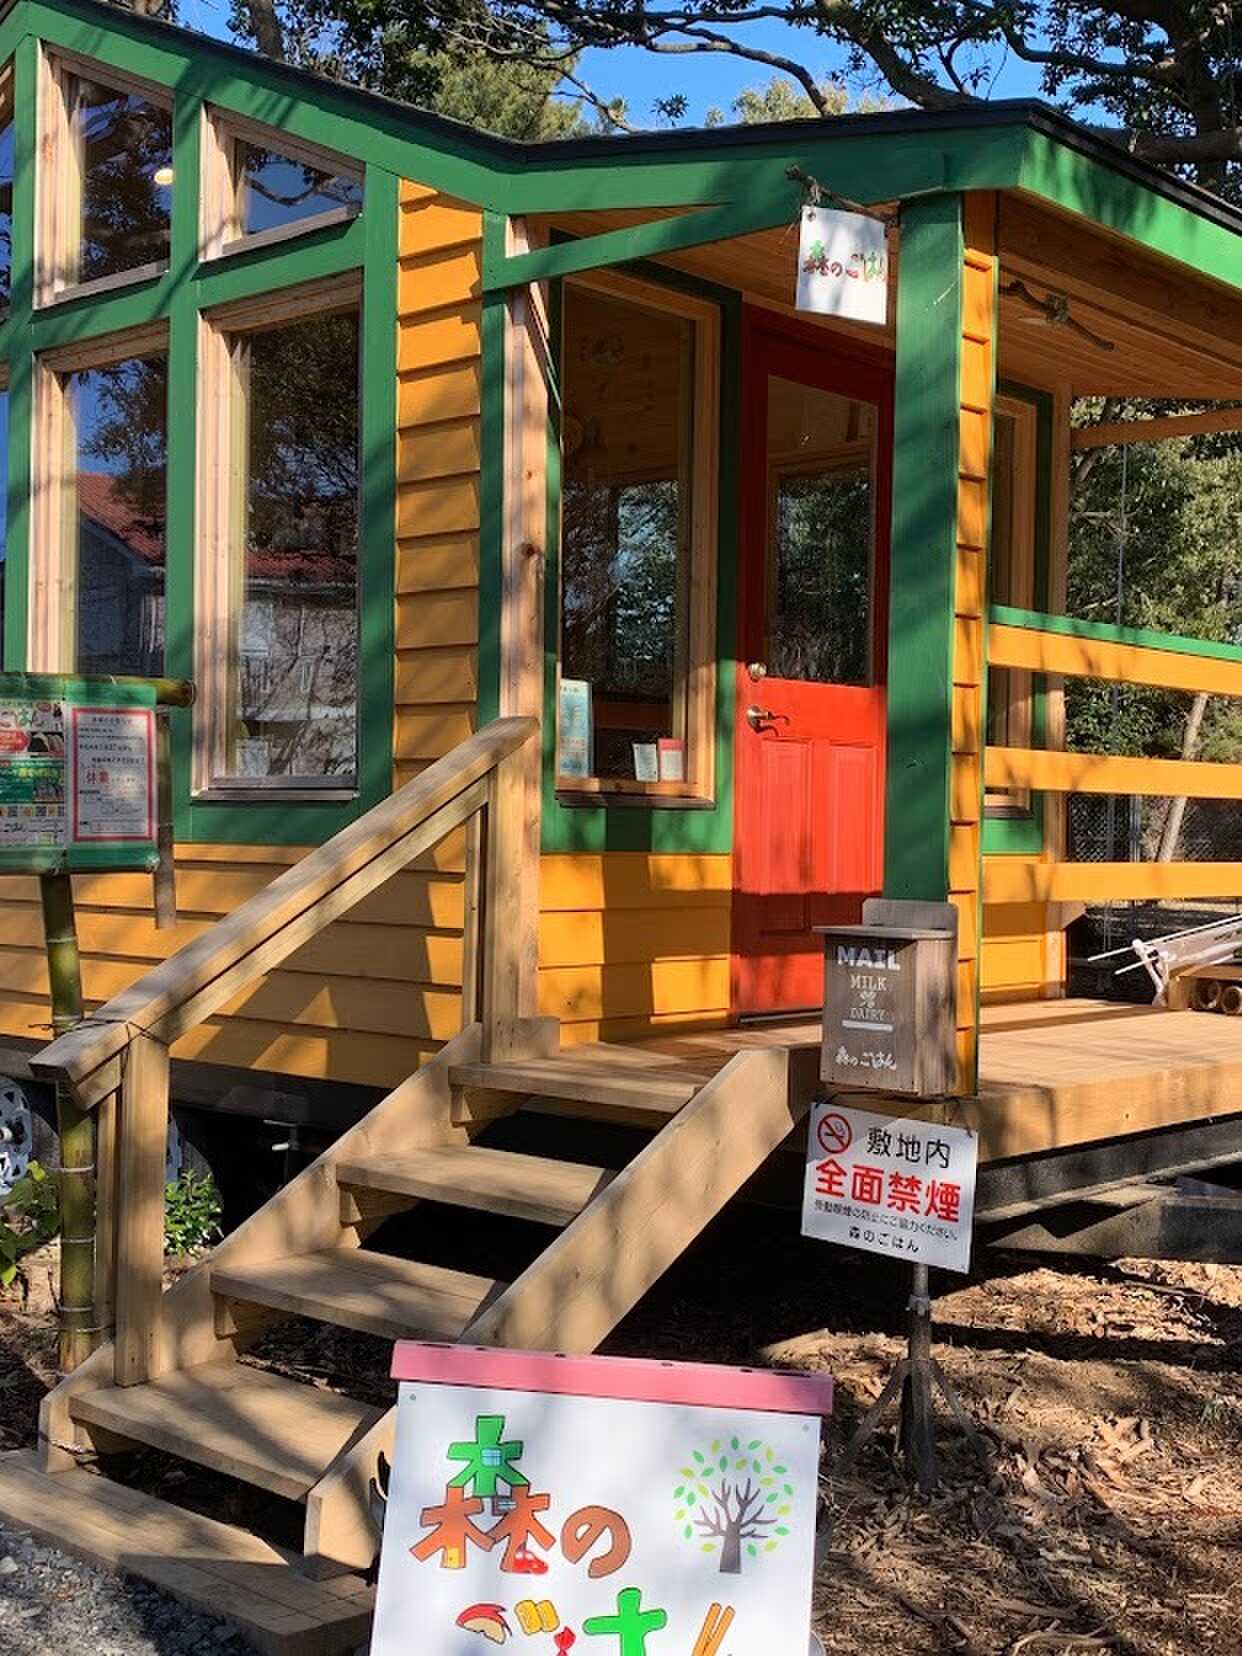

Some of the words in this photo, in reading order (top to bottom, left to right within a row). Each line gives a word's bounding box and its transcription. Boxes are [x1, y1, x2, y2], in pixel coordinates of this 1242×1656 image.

[836, 945, 901, 971] MAIL
[850, 975, 887, 991] MILK
[849, 1007, 887, 1021] DAIRY
[835, 1045, 897, 1071] 森のごはん
[866, 1127, 951, 1169] 敷地内
[815, 1158, 961, 1223] 全面禁煙
[848, 1226, 920, 1253] 森のごはん
[408, 1413, 633, 1580] 森の
